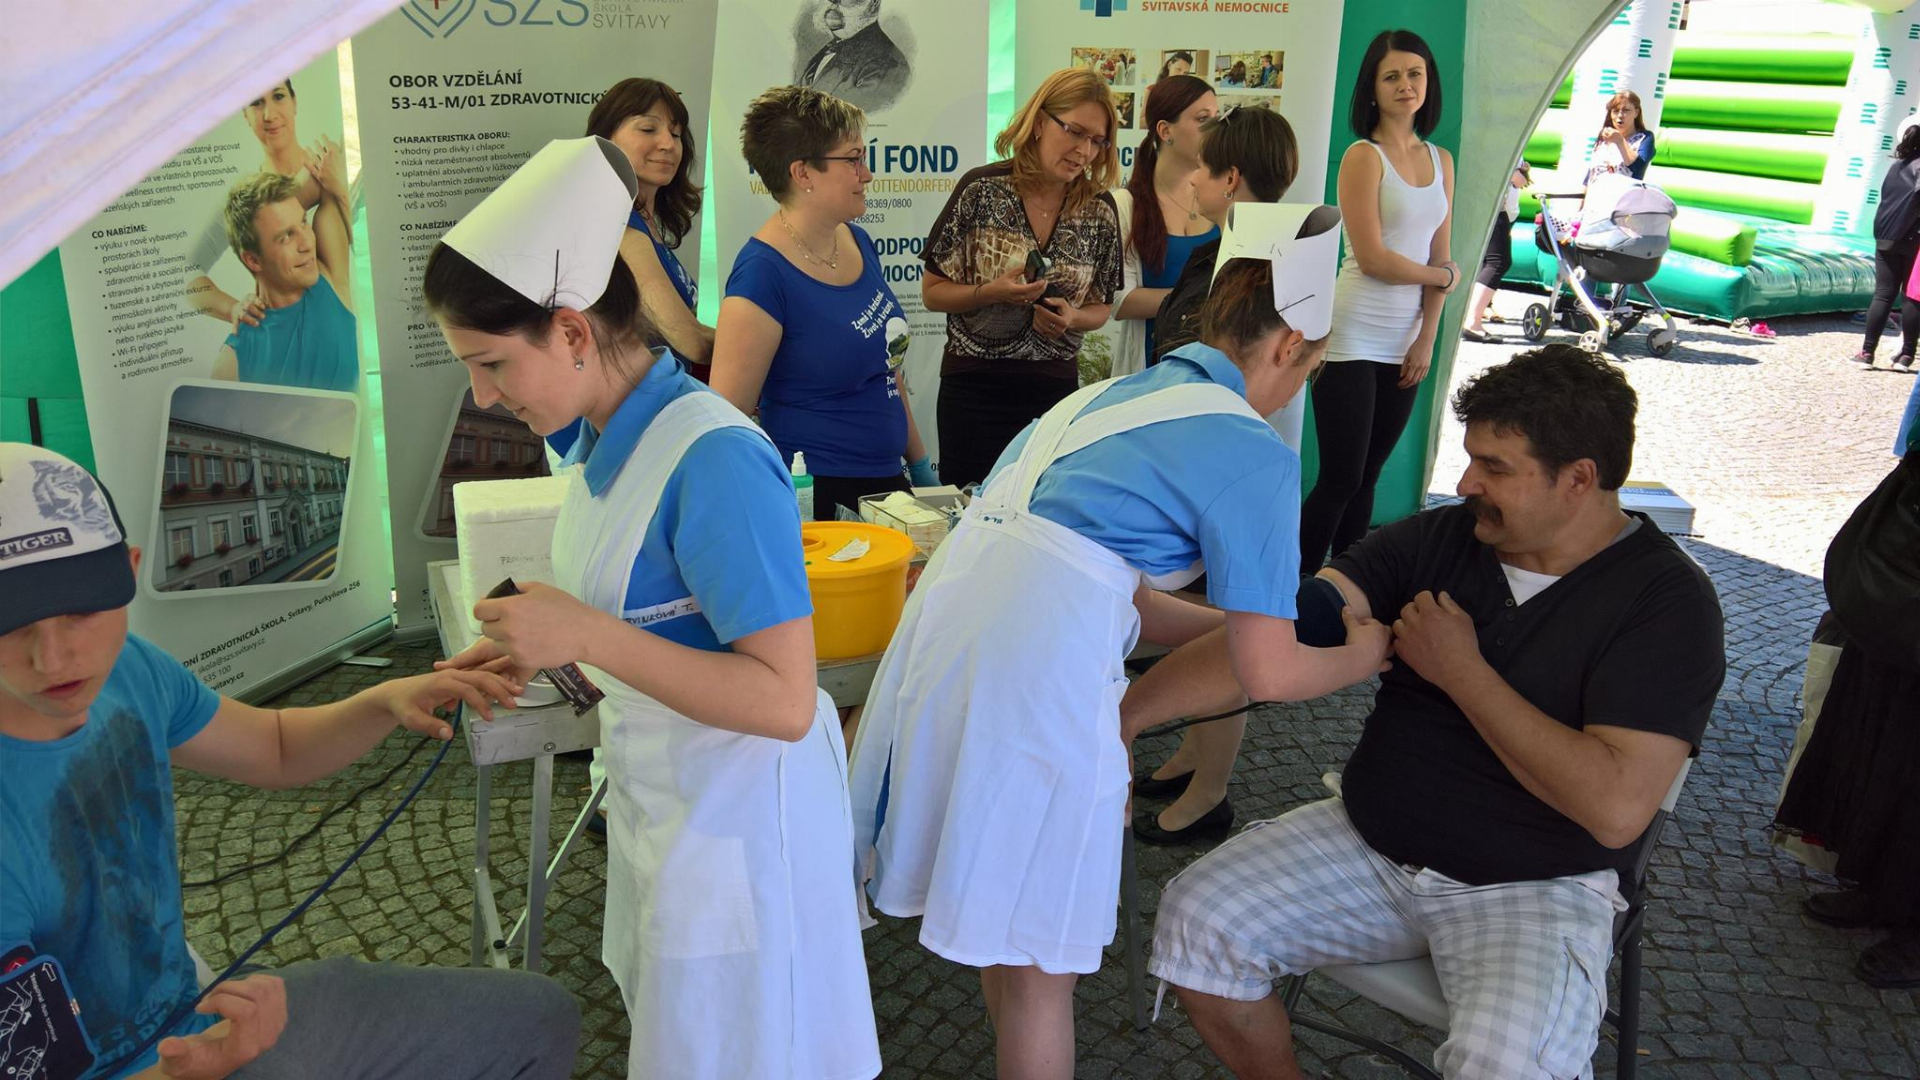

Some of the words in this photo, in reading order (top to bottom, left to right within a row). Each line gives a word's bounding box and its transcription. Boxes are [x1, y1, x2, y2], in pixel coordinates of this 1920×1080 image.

[1142, 0, 1208, 12] SVITAVSKÁ
[1215, 2, 1289, 13] NEMOCNICE
[592, 14, 671, 29] SVITAVY
[389, 75, 438, 88] OBOR
[443, 69, 523, 87] VZDĚLÁNÍ
[391, 95, 486, 110] 53-41-M/01
[393, 133, 476, 144] CHARAKTERISTIKA
[477, 131, 511, 141] OBORU:
[400, 146, 431, 156] vhodný
[433, 147, 447, 156] pro
[475, 142, 506, 152] chlapce
[425, 154, 489, 165] nezaměstnanost
[490, 151, 531, 161] absolventů
[884, 145, 959, 173] FOND
[402, 168, 441, 179] uplatnění
[400, 223, 413, 231] CO
[91, 230, 105, 239] CO
[407, 323, 425, 331] PRO
[0, 532, 69, 554] TIGER
[200, 625, 260, 661] ZDRAVOTNICKÁ
[260, 616, 287, 633] ŠKOLA,
